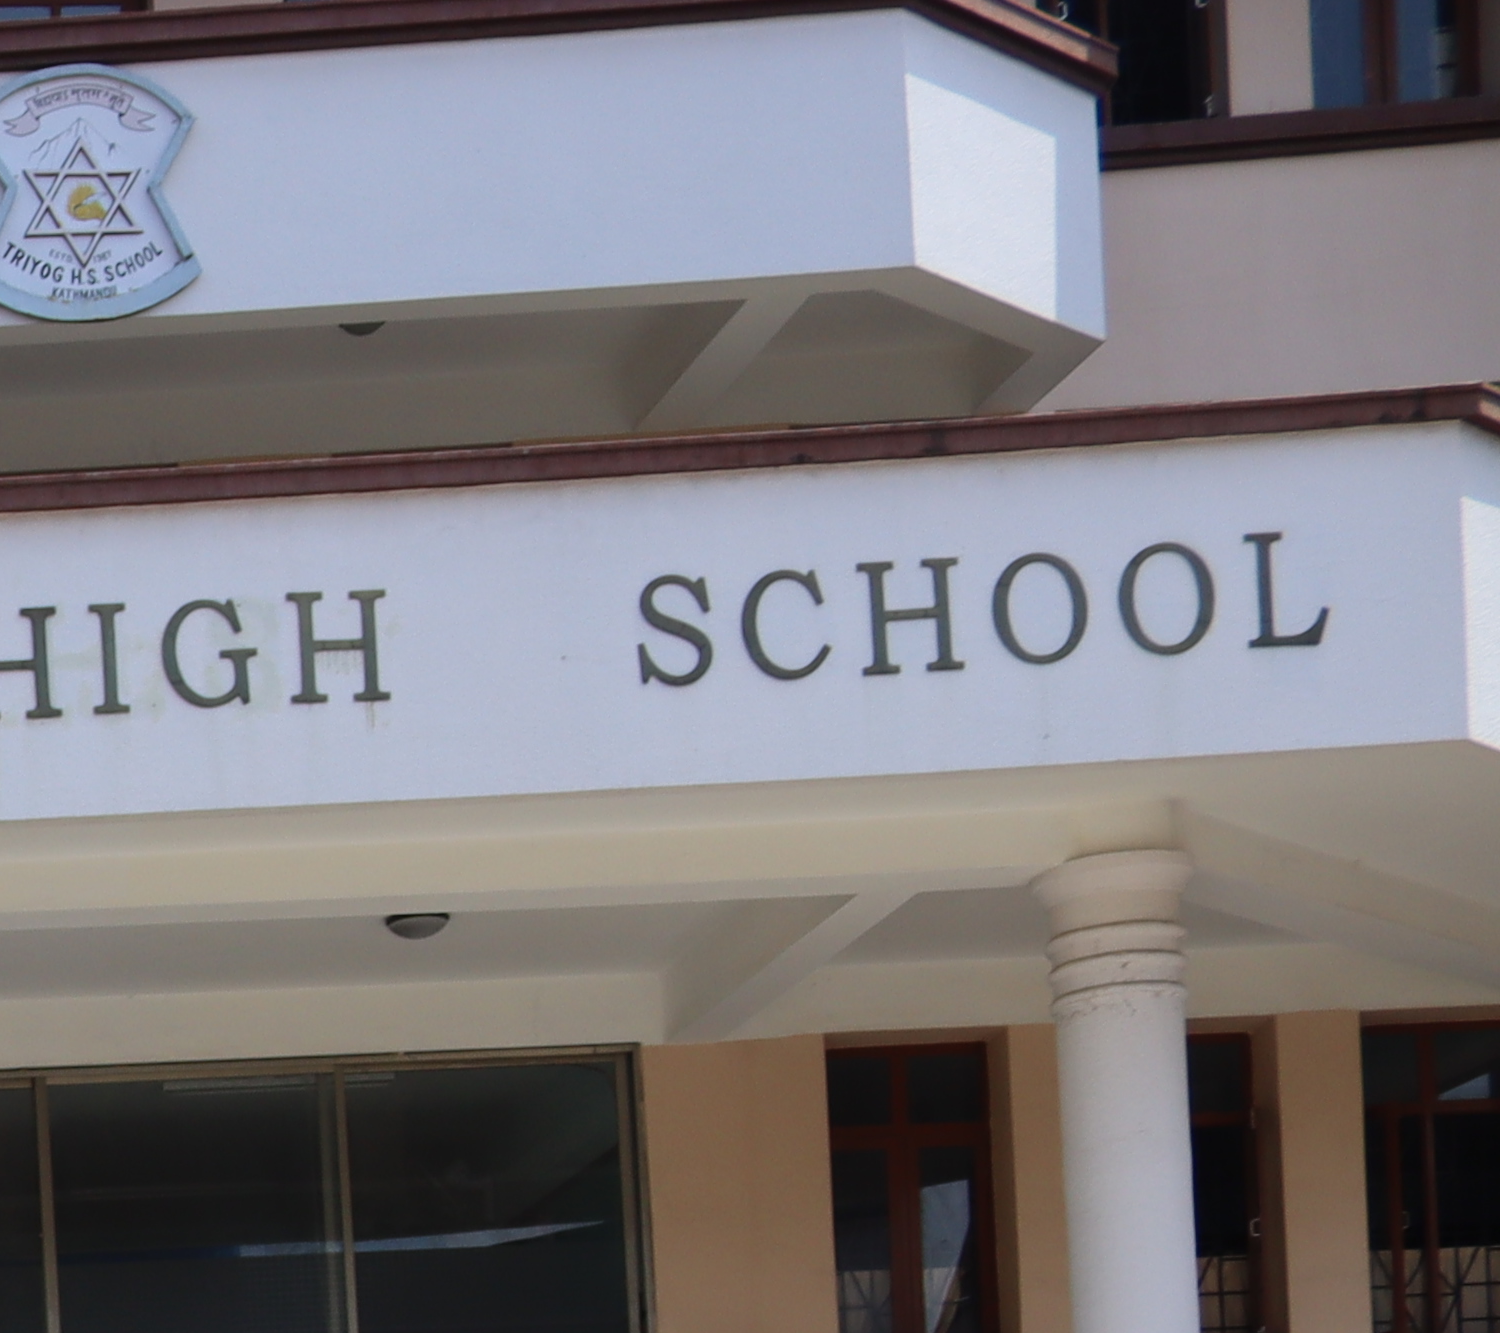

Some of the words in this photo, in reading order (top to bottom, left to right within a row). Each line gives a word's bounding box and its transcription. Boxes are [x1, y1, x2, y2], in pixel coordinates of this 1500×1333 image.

[2, 242, 65, 284] TRIYOG
[103, 241, 164, 283] SCHOOL
[632, 530, 1334, 690] SCHOOL
